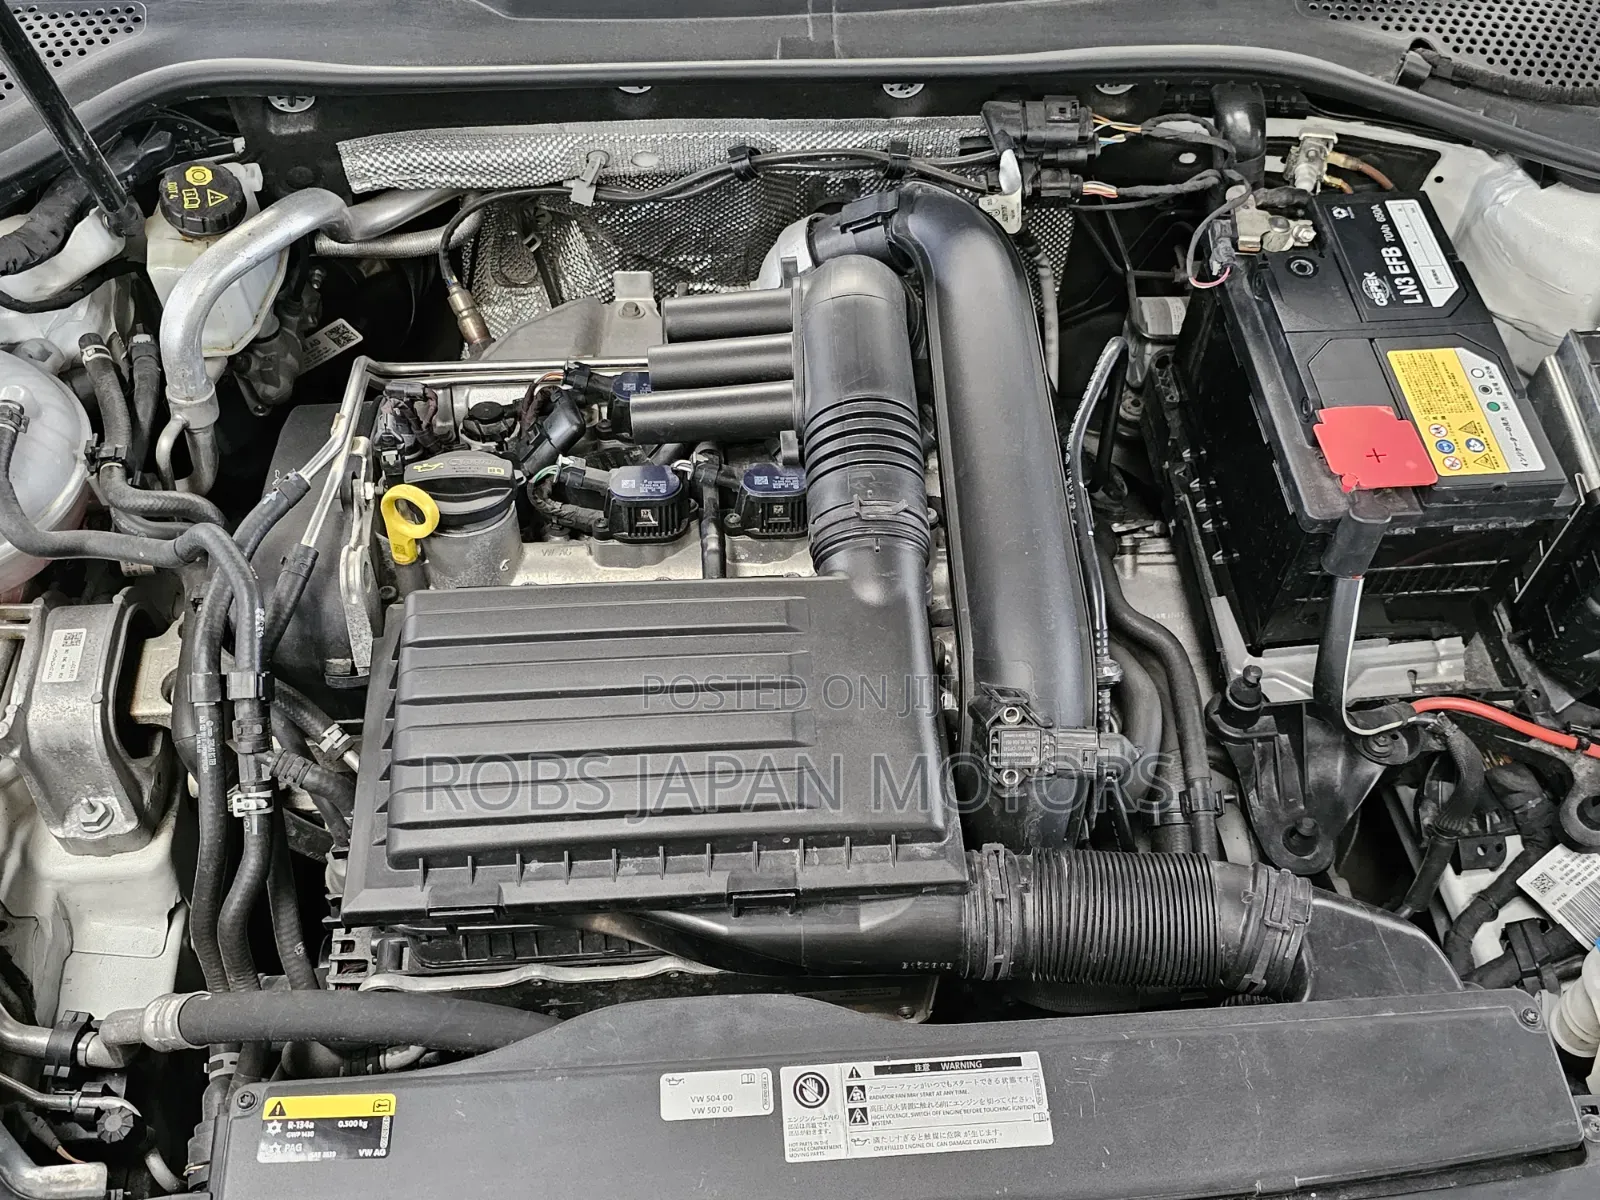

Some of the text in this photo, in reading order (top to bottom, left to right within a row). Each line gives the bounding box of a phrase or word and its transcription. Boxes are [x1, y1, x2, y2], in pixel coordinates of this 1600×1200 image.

[1370, 203, 1387, 223] 650A
[1380, 223, 1396, 242] 70Ah
[1380, 246, 1411, 275] EFB
[1363, 271, 1389, 307] GSPEK
[1394, 276, 1424, 304] LN3
[940, 1060, 982, 1071] WARNING
[707, 1106, 721, 1114] 507
[722, 1105, 734, 1113] 00
[287, 1121, 315, 1129] R-134a
[338, 1120, 369, 1129] 0.500 kg
[284, 1143, 303, 1153] PAG
[873, 1144, 904, 1152] OVERFILLED
[904, 1142, 925, 1150] ENGINE
[358, 1148, 387, 1157] VW AG
